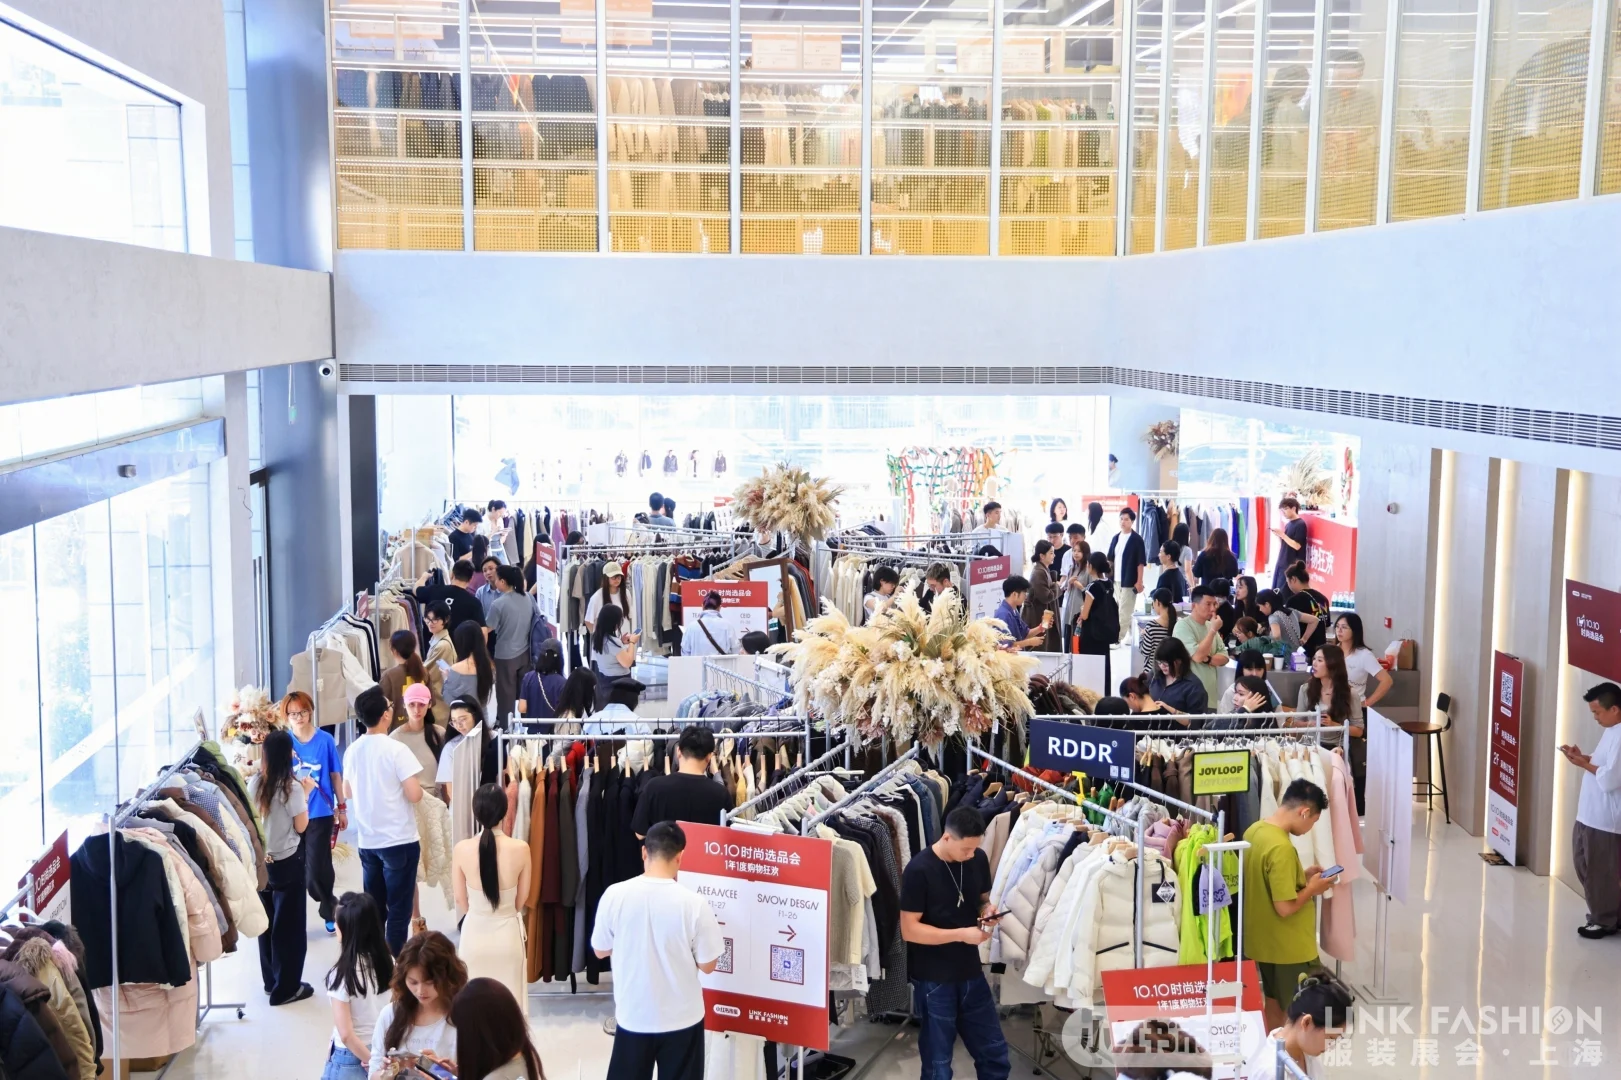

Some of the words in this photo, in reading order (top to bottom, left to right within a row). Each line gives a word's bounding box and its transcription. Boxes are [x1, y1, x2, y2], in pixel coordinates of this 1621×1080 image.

[1198, 765, 1244, 776] JOYLOOP
[704, 841, 801, 866] 10.10时尚选品会
[725, 860, 780, 877] 1年1度购物狂欢
[757, 893, 788, 906] SNOW
[763, 1011, 788, 1021] FASHION
